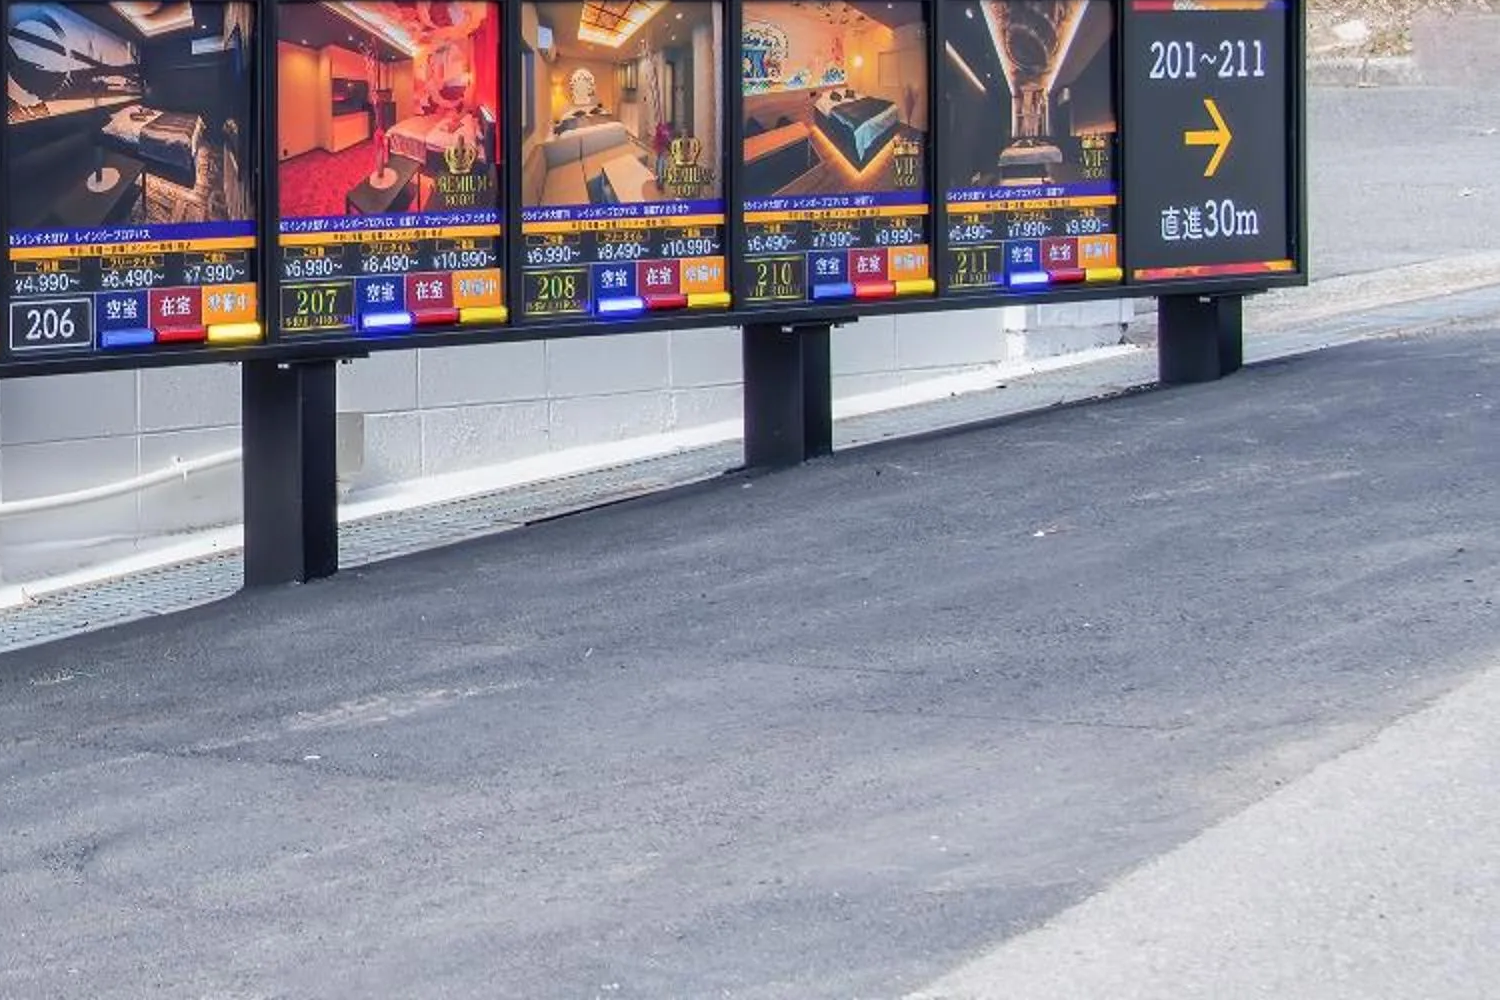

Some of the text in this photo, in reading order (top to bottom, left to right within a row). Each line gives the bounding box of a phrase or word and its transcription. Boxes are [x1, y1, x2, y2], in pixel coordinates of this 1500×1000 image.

[1161, 200, 1259, 240] 直進30m
[758, 263, 792, 285] 210
[957, 251, 987, 273] 211
[538, 276, 575, 299] 208
[297, 289, 337, 315] 207
[26, 309, 74, 340] 206
[160, 296, 191, 316] 在室
